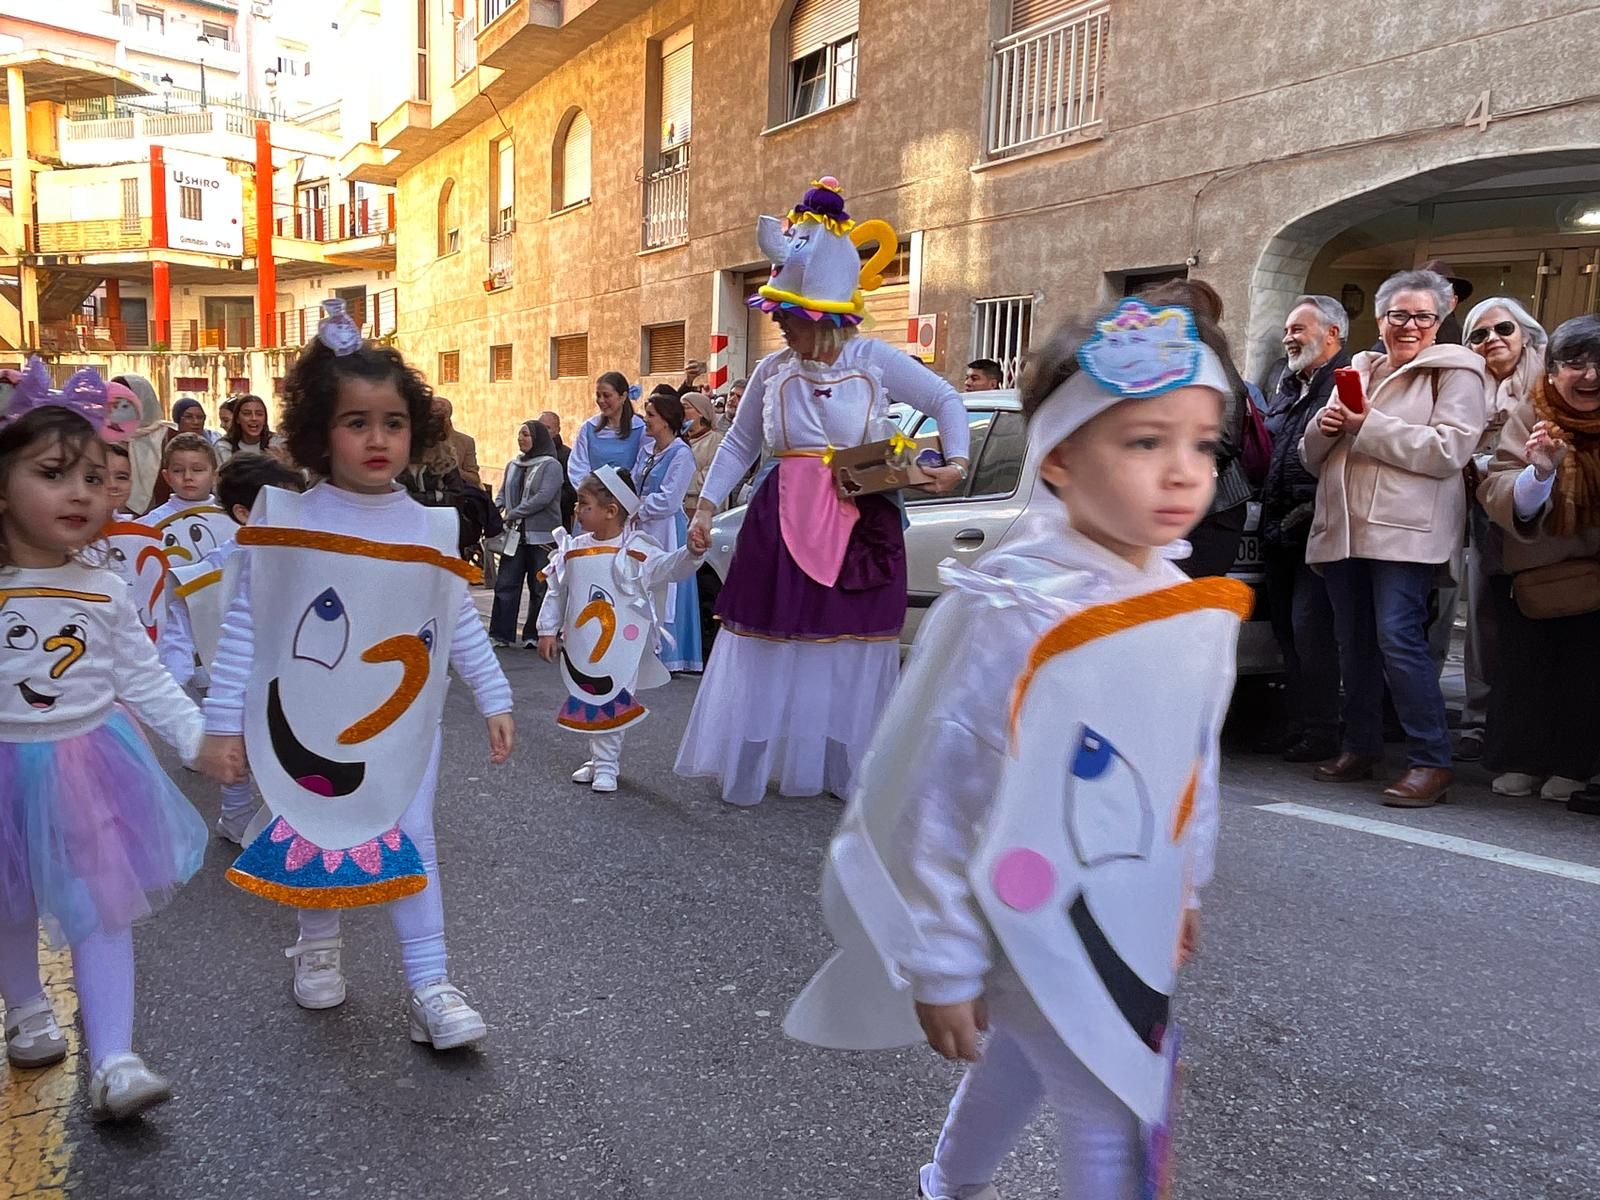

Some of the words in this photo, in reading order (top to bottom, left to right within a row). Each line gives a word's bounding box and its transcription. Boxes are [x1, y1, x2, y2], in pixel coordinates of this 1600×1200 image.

[1465, 90, 1492, 132] 4
[173, 169, 220, 190] USHIRO
[1237, 539, 1264, 562] 08
